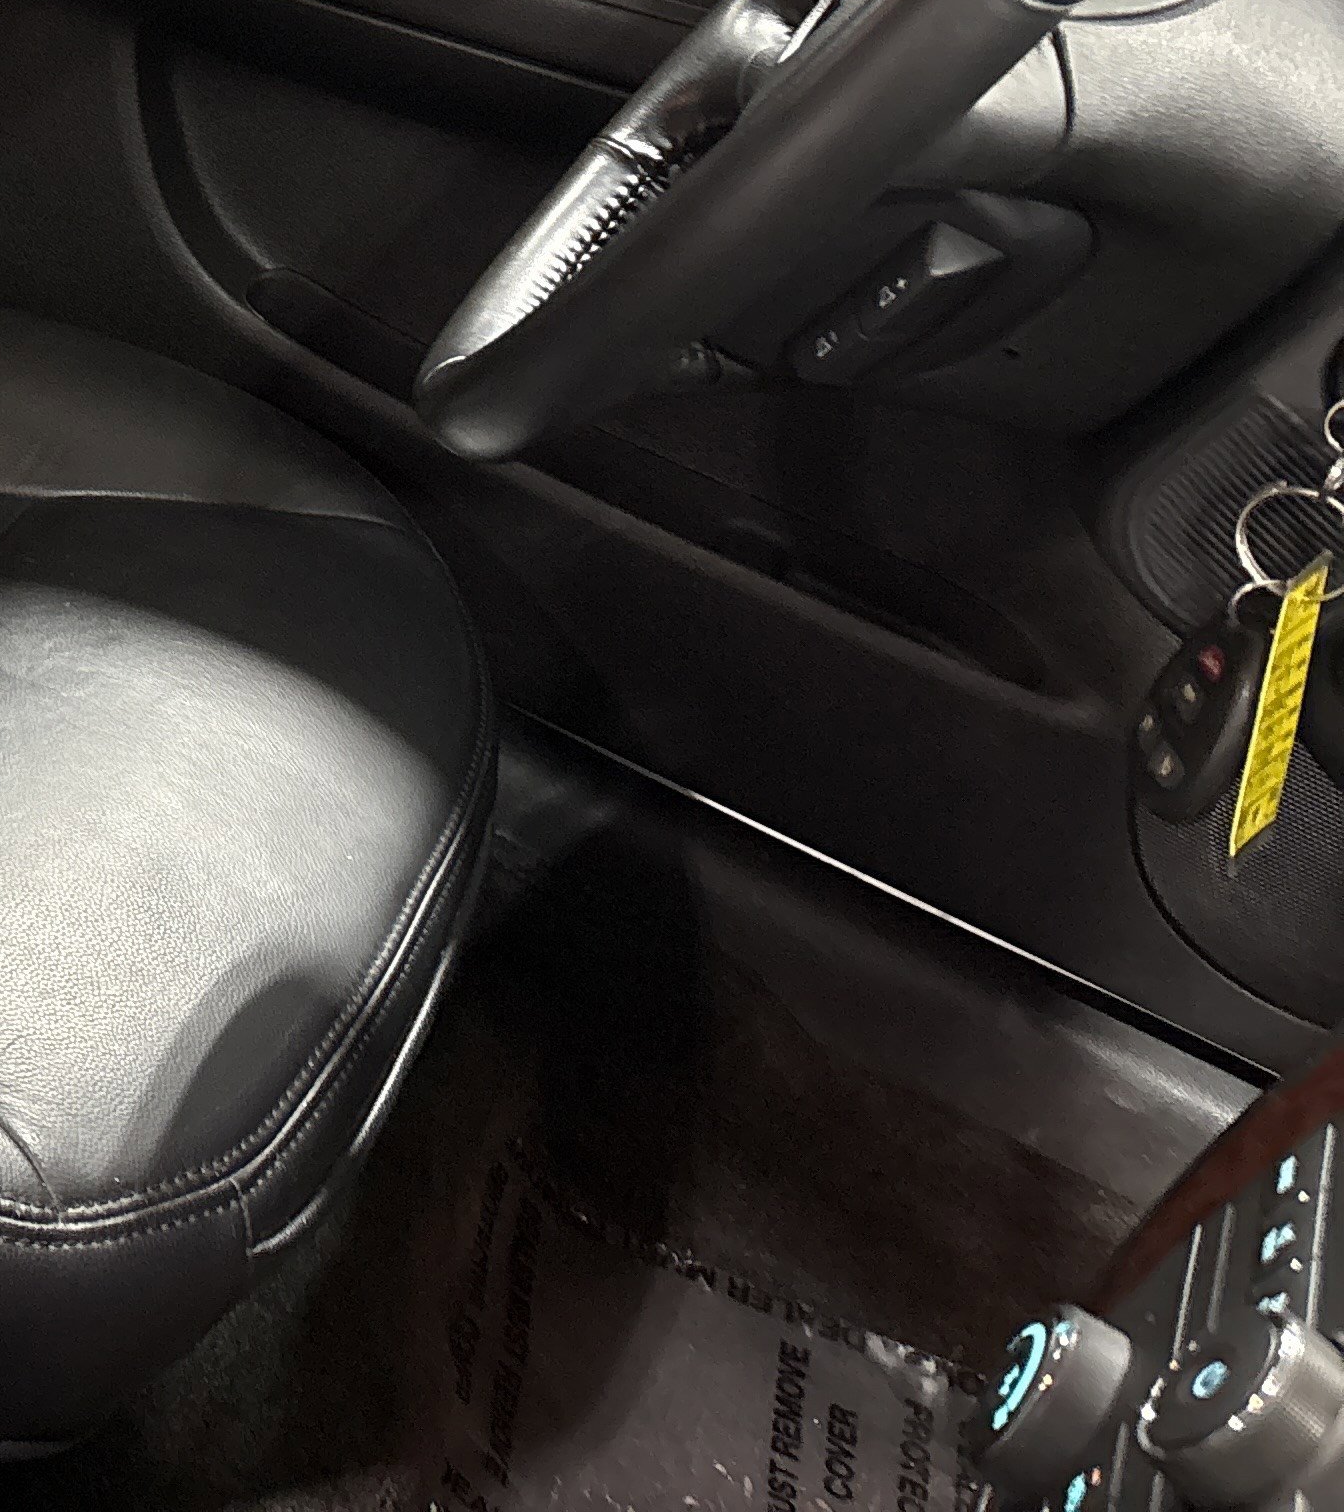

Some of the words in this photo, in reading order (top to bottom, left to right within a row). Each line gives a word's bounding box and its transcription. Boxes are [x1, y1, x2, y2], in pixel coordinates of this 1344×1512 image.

[770, 1338, 811, 1463] REMOVE
[767, 1458, 799, 1512] UST
[823, 1402, 859, 1502] COVER
